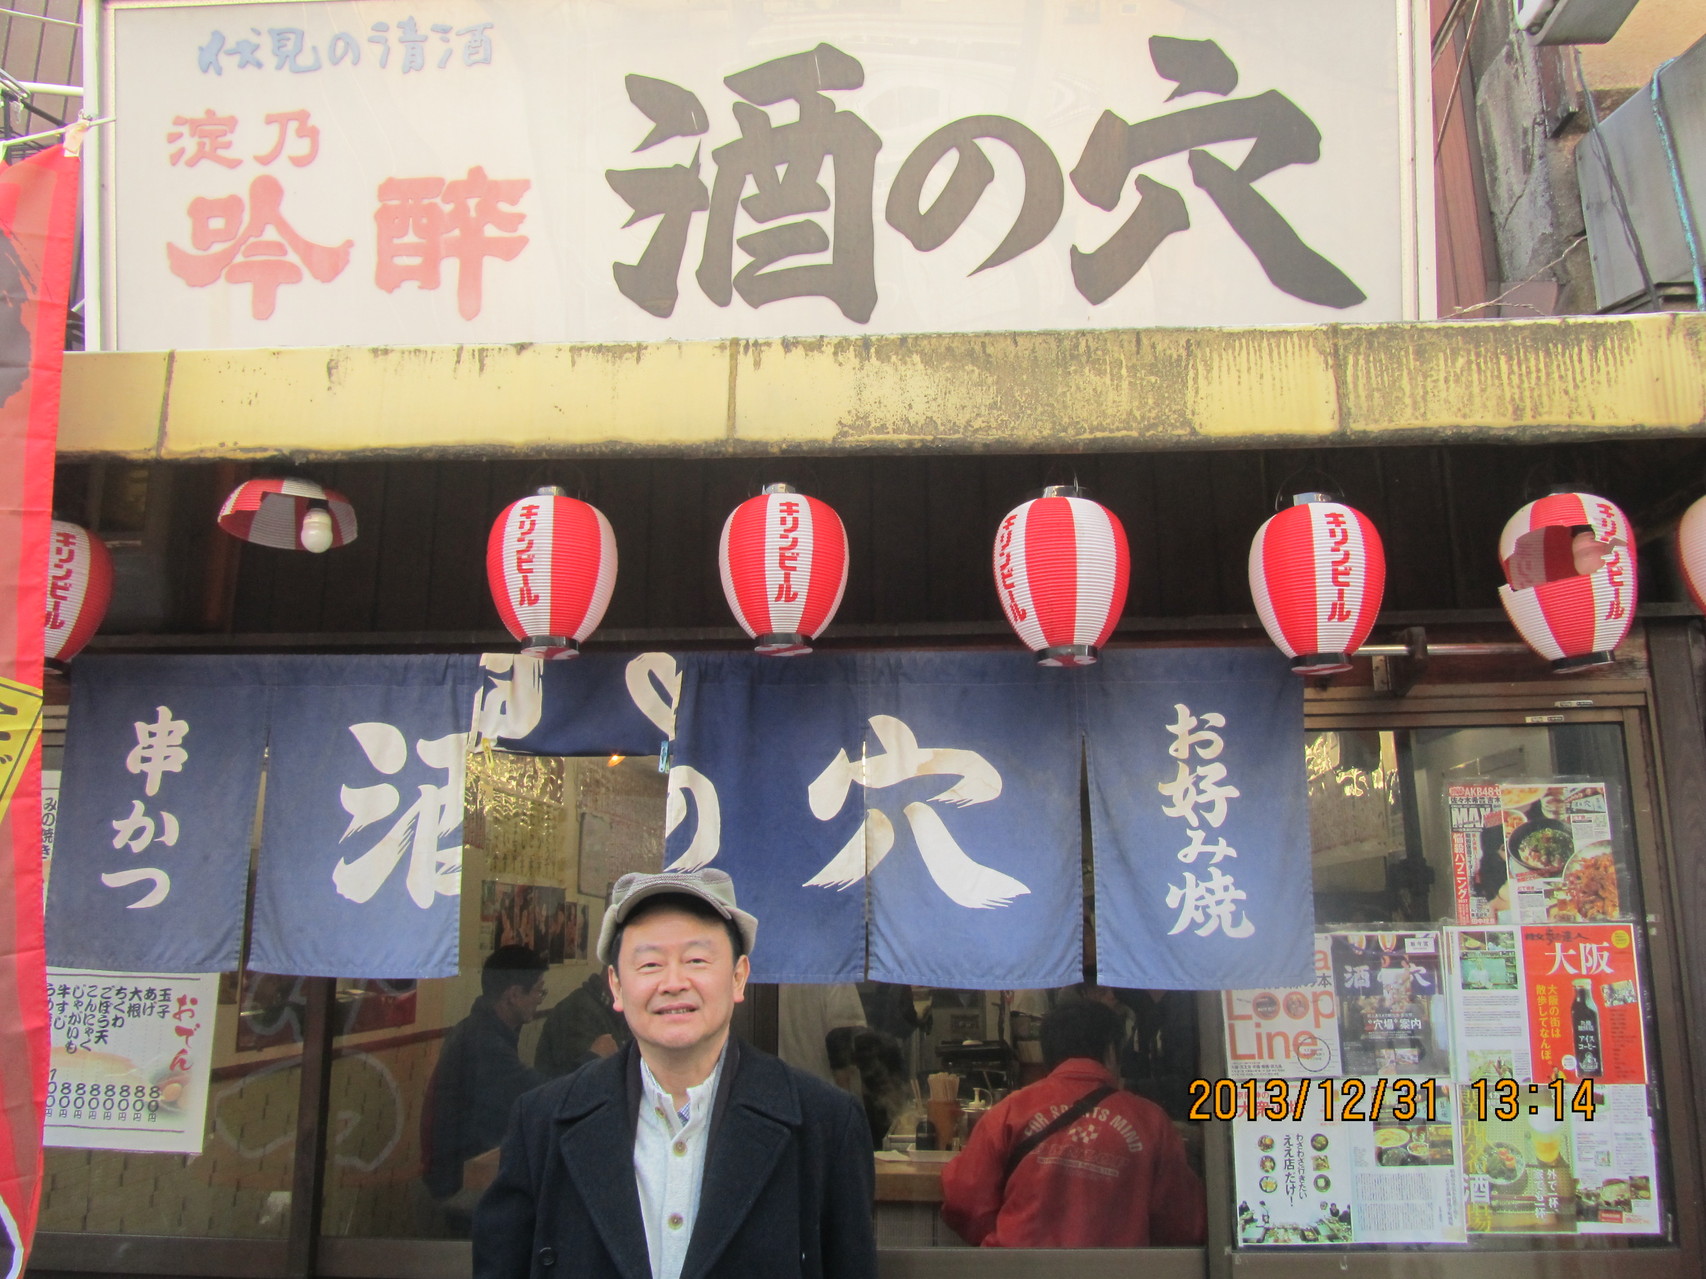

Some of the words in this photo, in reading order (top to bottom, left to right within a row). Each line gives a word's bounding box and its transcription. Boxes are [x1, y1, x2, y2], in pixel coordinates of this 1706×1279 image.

[198, 15, 495, 75] 伏見の清酒
[167, 109, 320, 169] 淀乃
[605, 35, 1368, 325] 酒の穴
[516, 504, 540, 606] キリンビール
[775, 502, 800, 603] キリンビール
[998, 514, 1028, 623] キリンビール
[1325, 512, 1352, 622] キリンビール
[101, 705, 190, 910] 串かつ
[1157, 703, 1257, 940] お好み焼
[1545, 942, 1614, 975] 大阪
[54, 984, 71, 1030] 牛すじ
[66, 984, 86, 1054] じゃがいも
[80, 985, 97, 1052] こんにゃく
[94, 985, 116, 1044] ごぼう天
[111, 986, 127, 1028] ちくわ
[127, 987, 142, 1018] 大根
[142, 987, 158, 1016] あげ
[157, 988, 172, 1018] 玉子
[1226, 989, 1335, 1028] Loop
[1548, 985, 1561, 1038] 大阪の街は
[169, 993, 201, 1072] おでん
[1228, 1022, 1318, 1060] Line
[1109, 1115, 1144, 1152] MIND
